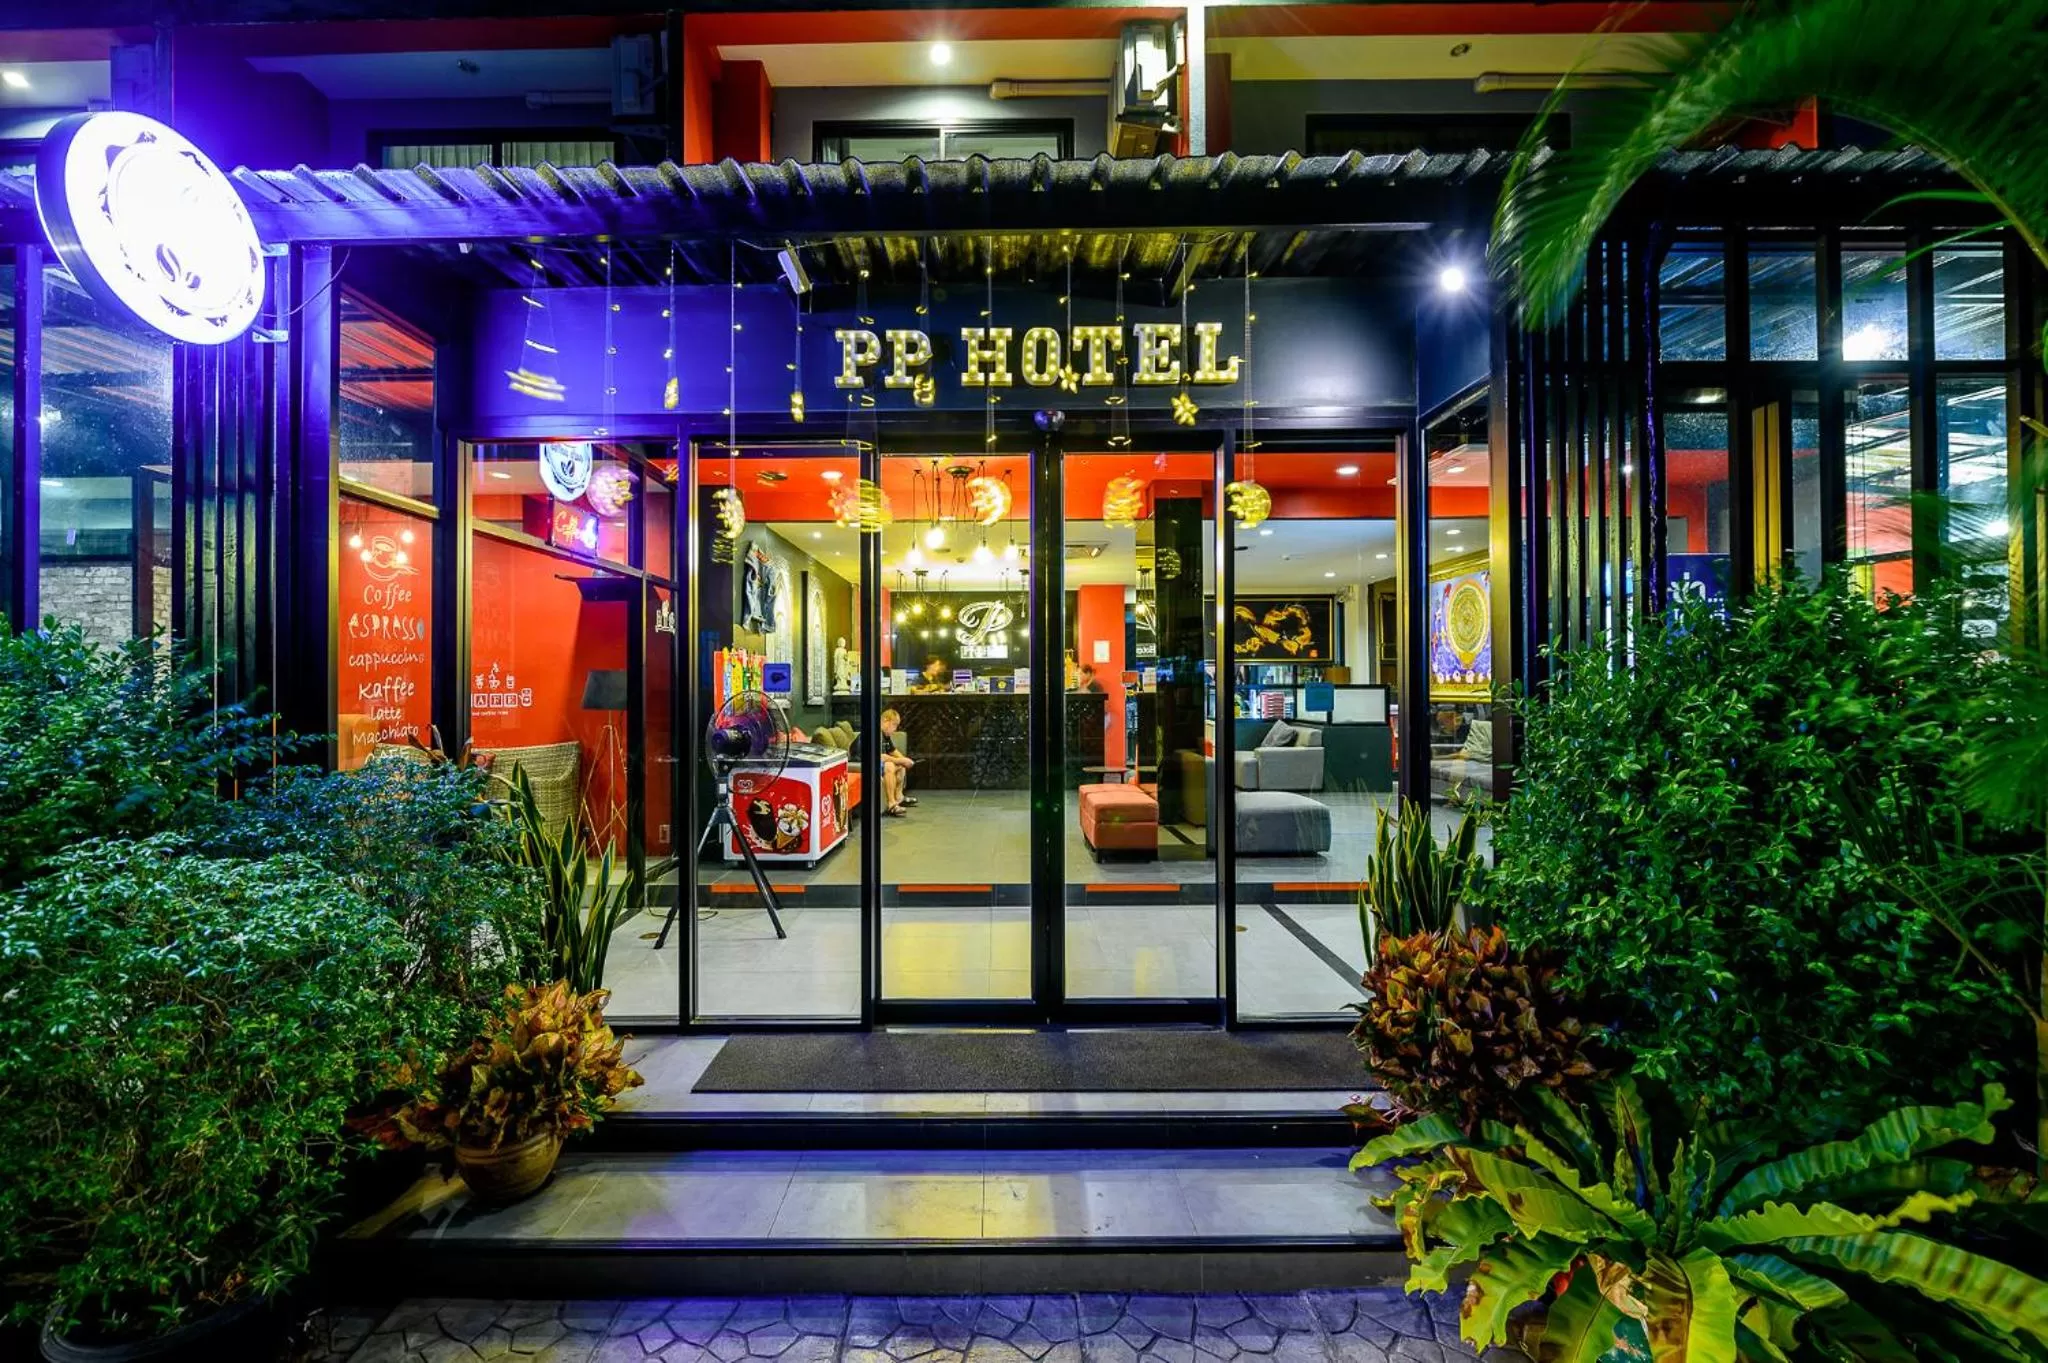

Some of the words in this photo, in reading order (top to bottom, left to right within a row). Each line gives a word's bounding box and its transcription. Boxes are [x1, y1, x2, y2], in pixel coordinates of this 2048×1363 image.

[834, 327, 932, 389] PP
[960, 322, 1243, 388] HOTEL
[363, 582, 412, 611] Coffee
